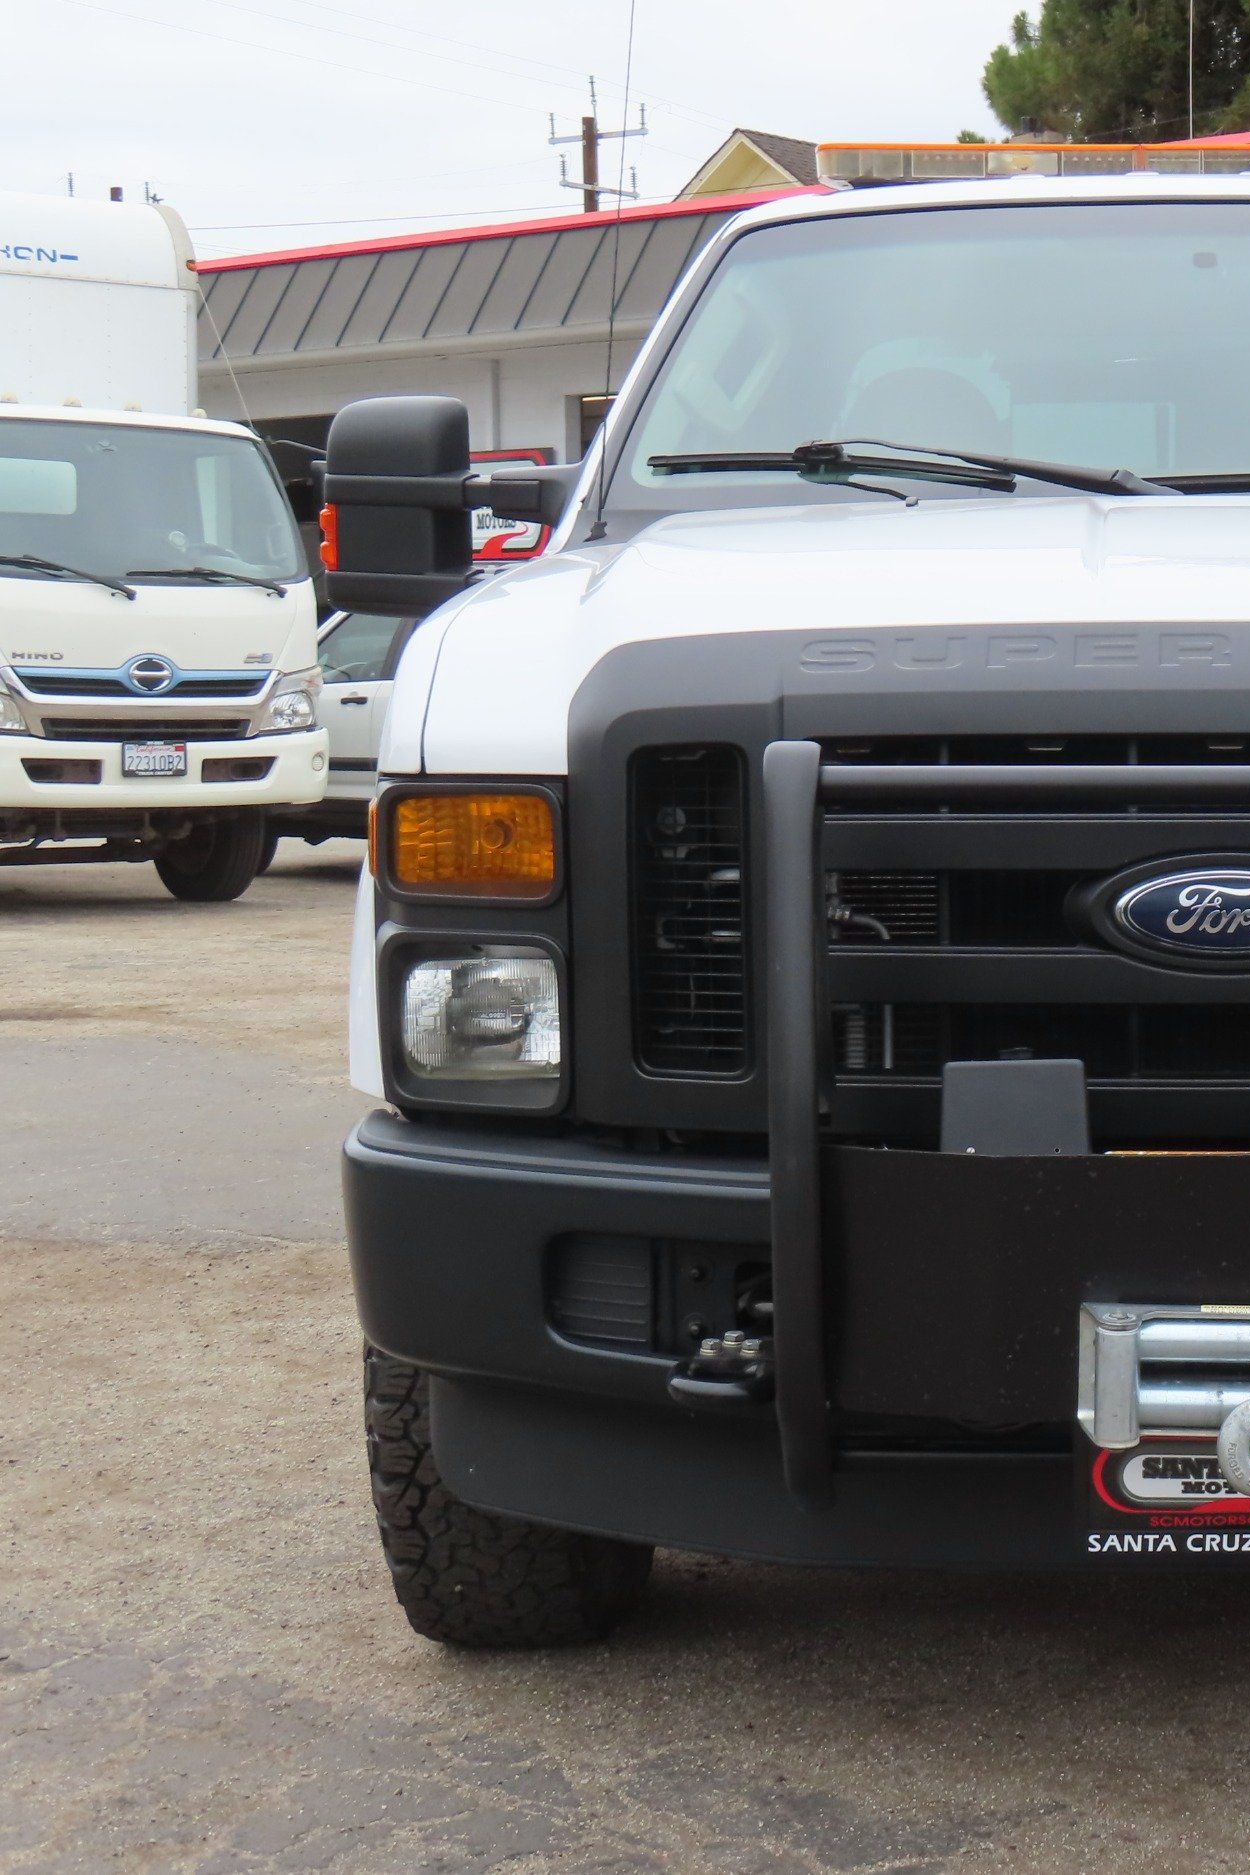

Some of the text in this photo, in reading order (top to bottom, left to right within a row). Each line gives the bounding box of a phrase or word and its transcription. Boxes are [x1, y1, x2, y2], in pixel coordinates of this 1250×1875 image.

[12, 652, 63, 660] HINO
[800, 633, 1231, 673] SUPER
[1142, 1457, 1222, 1479] SANT
[1088, 1534, 1177, 1552] SANTA
